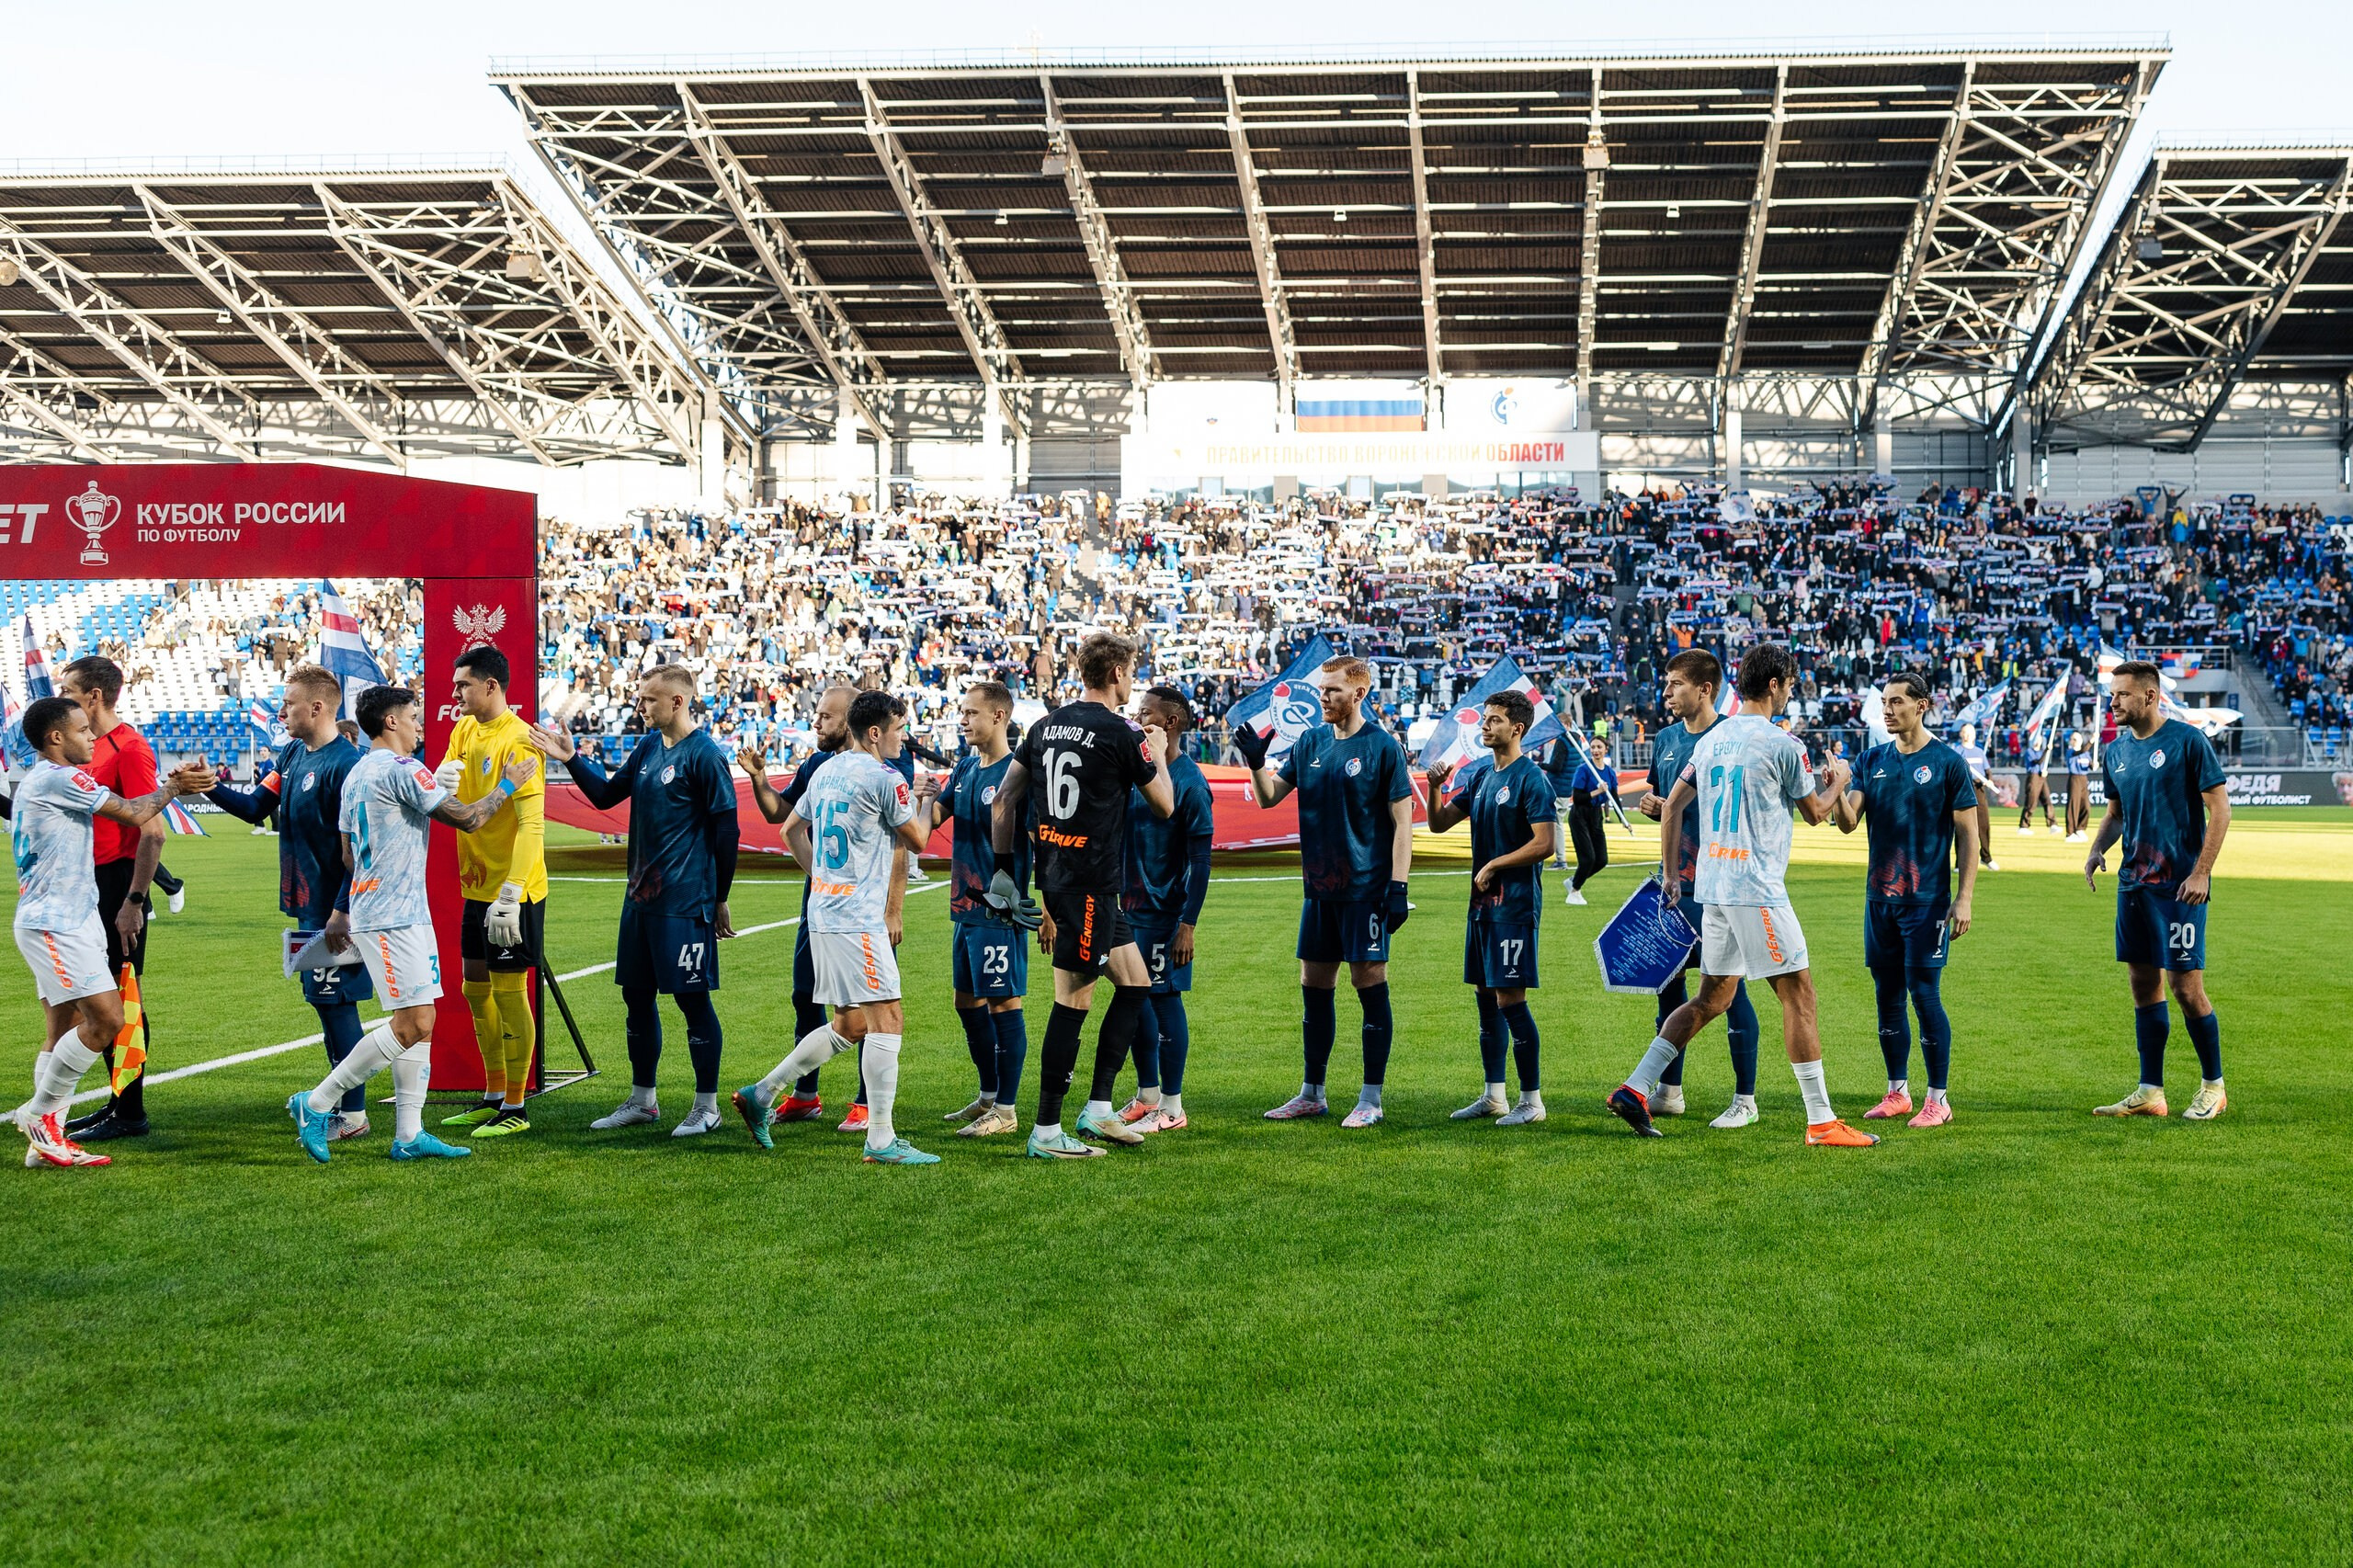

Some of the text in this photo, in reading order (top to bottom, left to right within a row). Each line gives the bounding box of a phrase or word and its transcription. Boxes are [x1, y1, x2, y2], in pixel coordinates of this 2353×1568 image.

[1486, 442, 1565, 462] ОБЛАСТИ
[137, 502, 346, 525] КУБОК РОССИИ
[137, 528, 241, 542] ПО ФУТБОЛУ
[1042, 725, 1096, 749] АДАМОВ Д.
[1042, 747, 1083, 820] 16
[2225, 774, 2281, 795] ФЕДЯ
[1710, 764, 1745, 834] 21
[2251, 794, 2312, 805] ФУТБОЛИСТ
[814, 798, 850, 870] 15
[1370, 913, 1379, 939] 6
[1936, 919, 1946, 947] 7
[2169, 922, 2196, 949] 20
[677, 942, 705, 971] 47
[983, 945, 1009, 974] 23
[1151, 943, 1165, 972] 5
[1499, 938, 1524, 966] 17
[428, 955, 440, 985] 3
